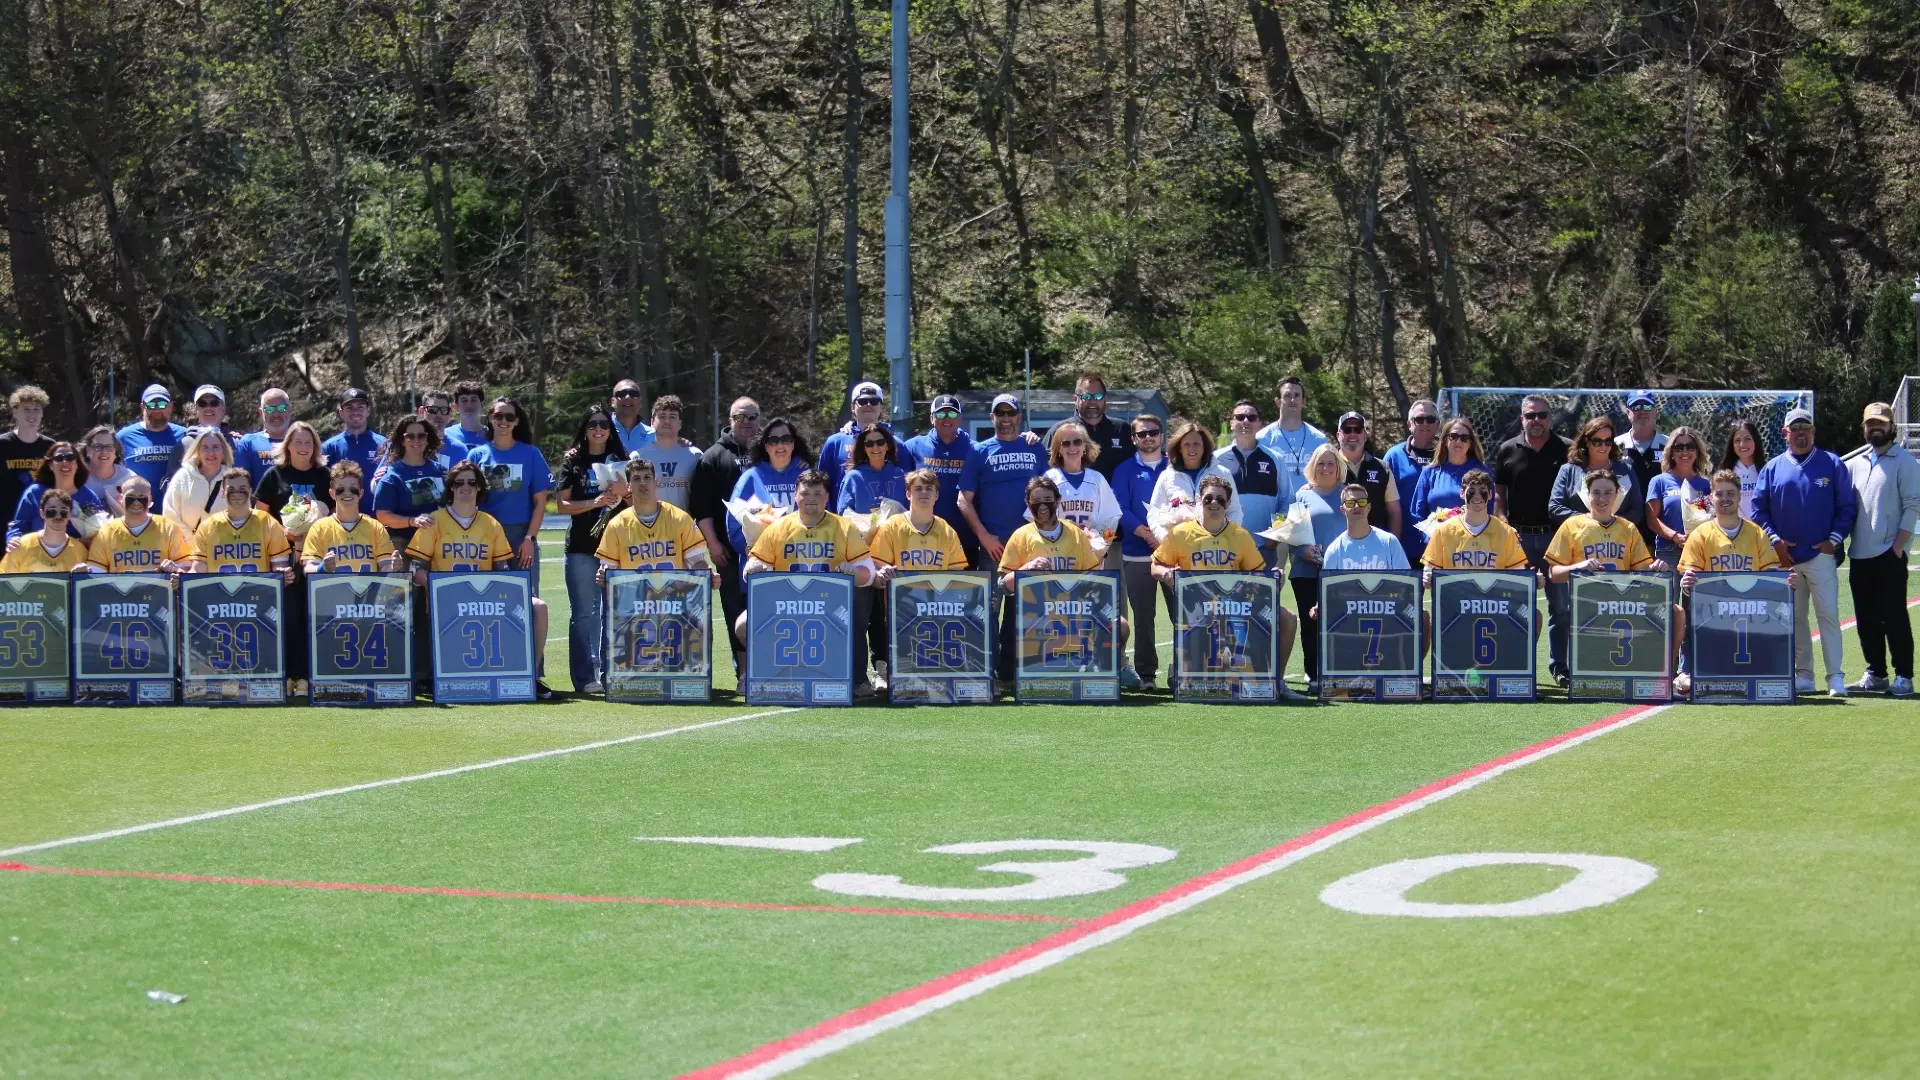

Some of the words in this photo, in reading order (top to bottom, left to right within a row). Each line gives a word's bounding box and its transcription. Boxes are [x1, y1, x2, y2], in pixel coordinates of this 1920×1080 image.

[133, 445, 175, 456] WIDENE
[987, 452, 1037, 465] WIDENER
[660, 462, 677, 477] W
[993, 463, 1035, 472] LACROSSE
[764, 484, 797, 492] WIDENE
[113, 550, 162, 568] PRIDE
[213, 543, 262, 561] PRIDE
[441, 542, 489, 560] PRIDE
[628, 540, 677, 562] PRIDE
[783, 542, 834, 560] PRIDE
[900, 550, 944, 567] PRIDE
[1583, 541, 1625, 560] PRIDE
[1452, 552, 1498, 568] PRIDE
[1710, 554, 1753, 571] PRIDE
[0, 602, 44, 616] PRIDE
[100, 603, 150, 618] PRIDE
[207, 603, 257, 619] PRIDE
[335, 604, 386, 619] PRIDE
[457, 602, 505, 617] PRIDE
[633, 600, 683, 615] PRIDE
[775, 600, 825, 615] PRIDE
[916, 602, 965, 617] PRIDE
[1044, 601, 1093, 616] PRIDE
[1202, 600, 1252, 616] PRIDE
[1346, 600, 1396, 615] PRIDE
[1460, 600, 1509, 614] PRIDE
[1597, 601, 1646, 616] PRIDE
[1717, 600, 1767, 615] PRIDE
[0, 621, 46, 669] 53
[101, 622, 150, 670] 46
[208, 622, 259, 671] 39
[334, 622, 389, 670] 34
[461, 619, 504, 669] 31
[631, 619, 684, 667] 29
[773, 619, 826, 667] 28
[915, 620, 966, 668] 26
[1043, 620, 1094, 668] 25
[1207, 619, 1250, 668] 17
[1358, 618, 1383, 666] 7
[1472, 618, 1498, 666] 6
[1609, 619, 1634, 667] 3
[1733, 617, 1751, 664] 1
